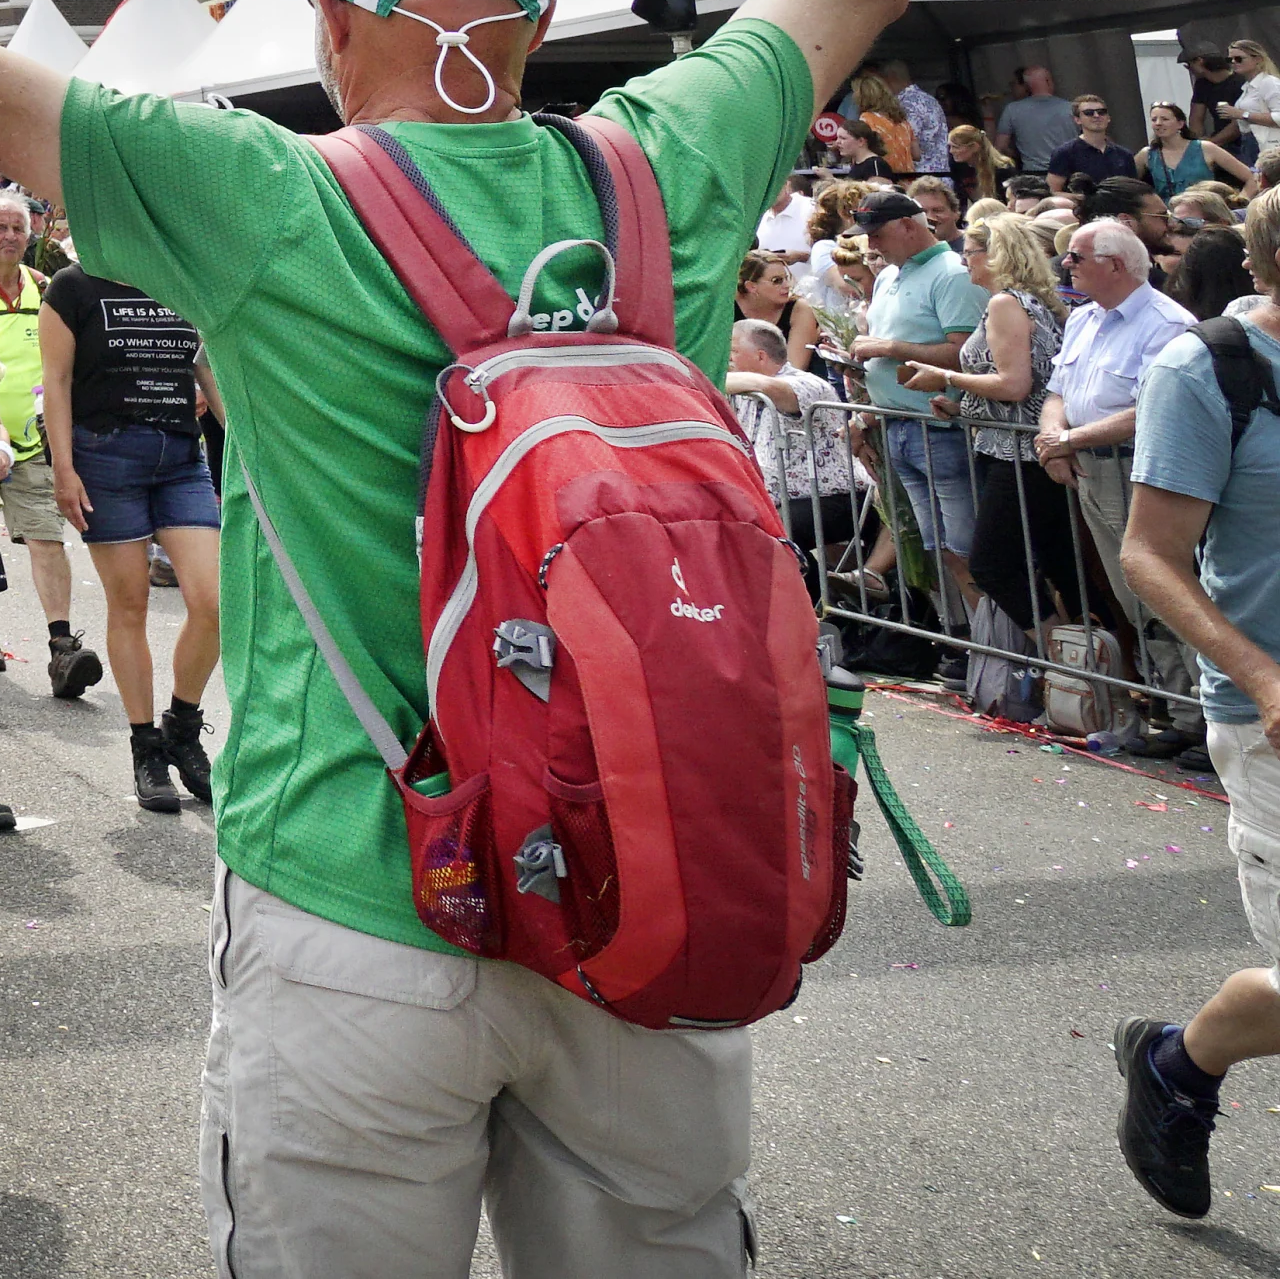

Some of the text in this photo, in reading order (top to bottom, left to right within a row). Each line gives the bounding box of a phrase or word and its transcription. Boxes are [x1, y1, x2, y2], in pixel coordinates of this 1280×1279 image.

[112, 308, 134, 316] LIFE
[136, 308, 146, 316] IS
[148, 308, 156, 316] A
[108, 338, 198, 350] DO WHAT YOU LOVE
[796, 781, 810, 881] speedlite
